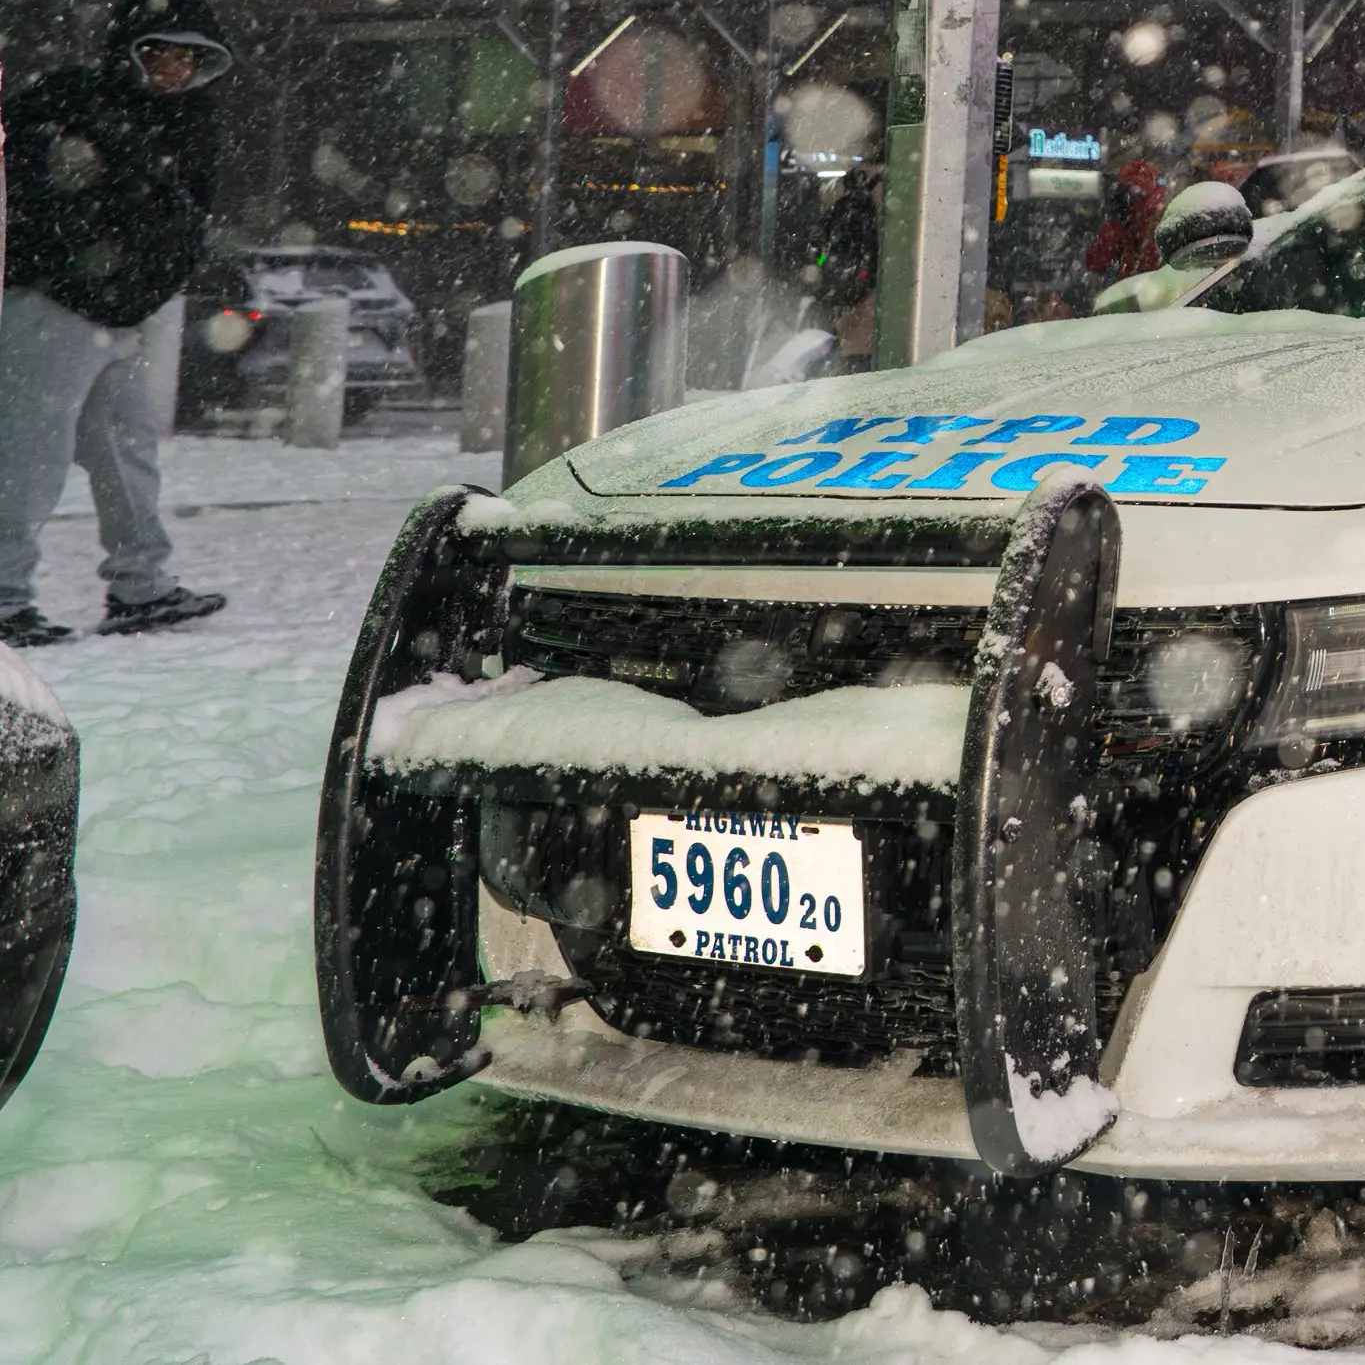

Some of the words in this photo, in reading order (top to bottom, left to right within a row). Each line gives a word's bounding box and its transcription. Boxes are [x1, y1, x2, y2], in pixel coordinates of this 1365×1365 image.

[775, 414, 1202, 447] NYPD
[658, 450, 1228, 496] POLICE
[684, 809, 800, 841] HIGHWAY
[650, 837, 790, 925] 5960
[799, 892, 842, 933] 20
[694, 929, 795, 967] PATROL
